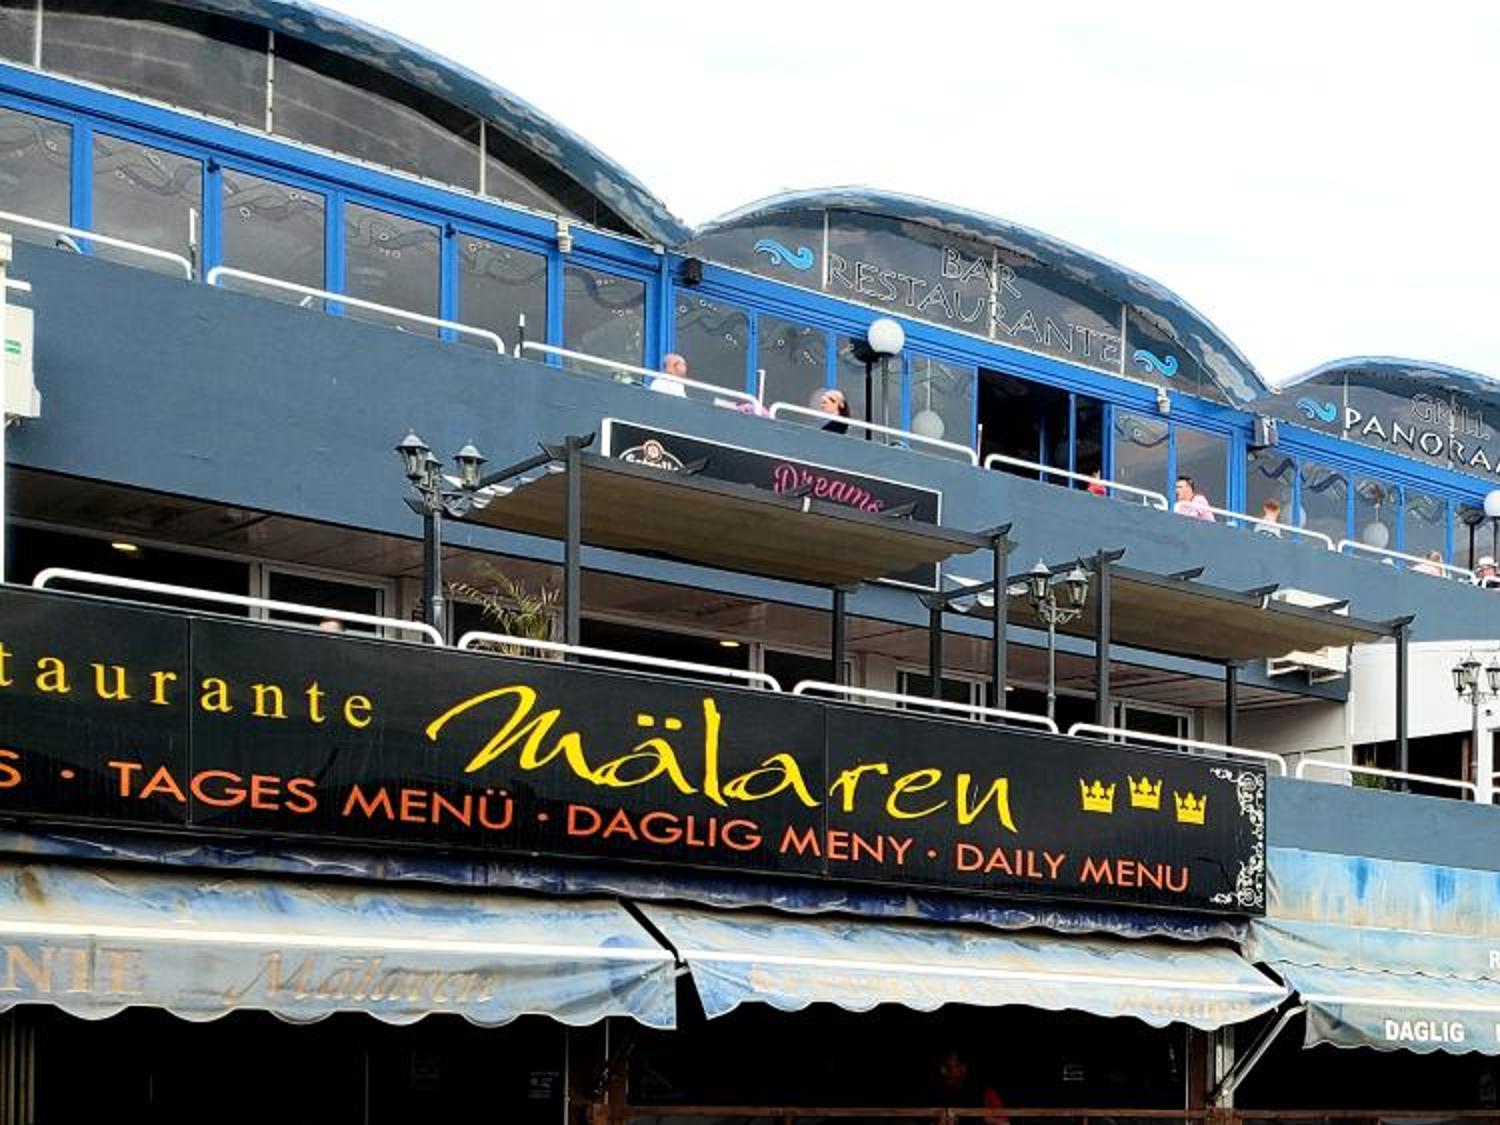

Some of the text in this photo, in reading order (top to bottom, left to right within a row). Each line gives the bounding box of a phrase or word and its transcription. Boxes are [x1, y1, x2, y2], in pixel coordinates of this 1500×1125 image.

[827, 252, 1122, 364] RESTAURANTE
[942, 247, 1021, 299] BAR
[426, 684, 1017, 832] Mälaren
[108, 761, 317, 813] TAGES
[343, 784, 514, 830] MENÜ
[566, 805, 762, 852] DAGLIG
[779, 826, 913, 865] MENY
[957, 842, 1067, 877] DAILY
[1080, 856, 1190, 893] MENU
[1385, 1019, 1465, 1043] DAGLIG
